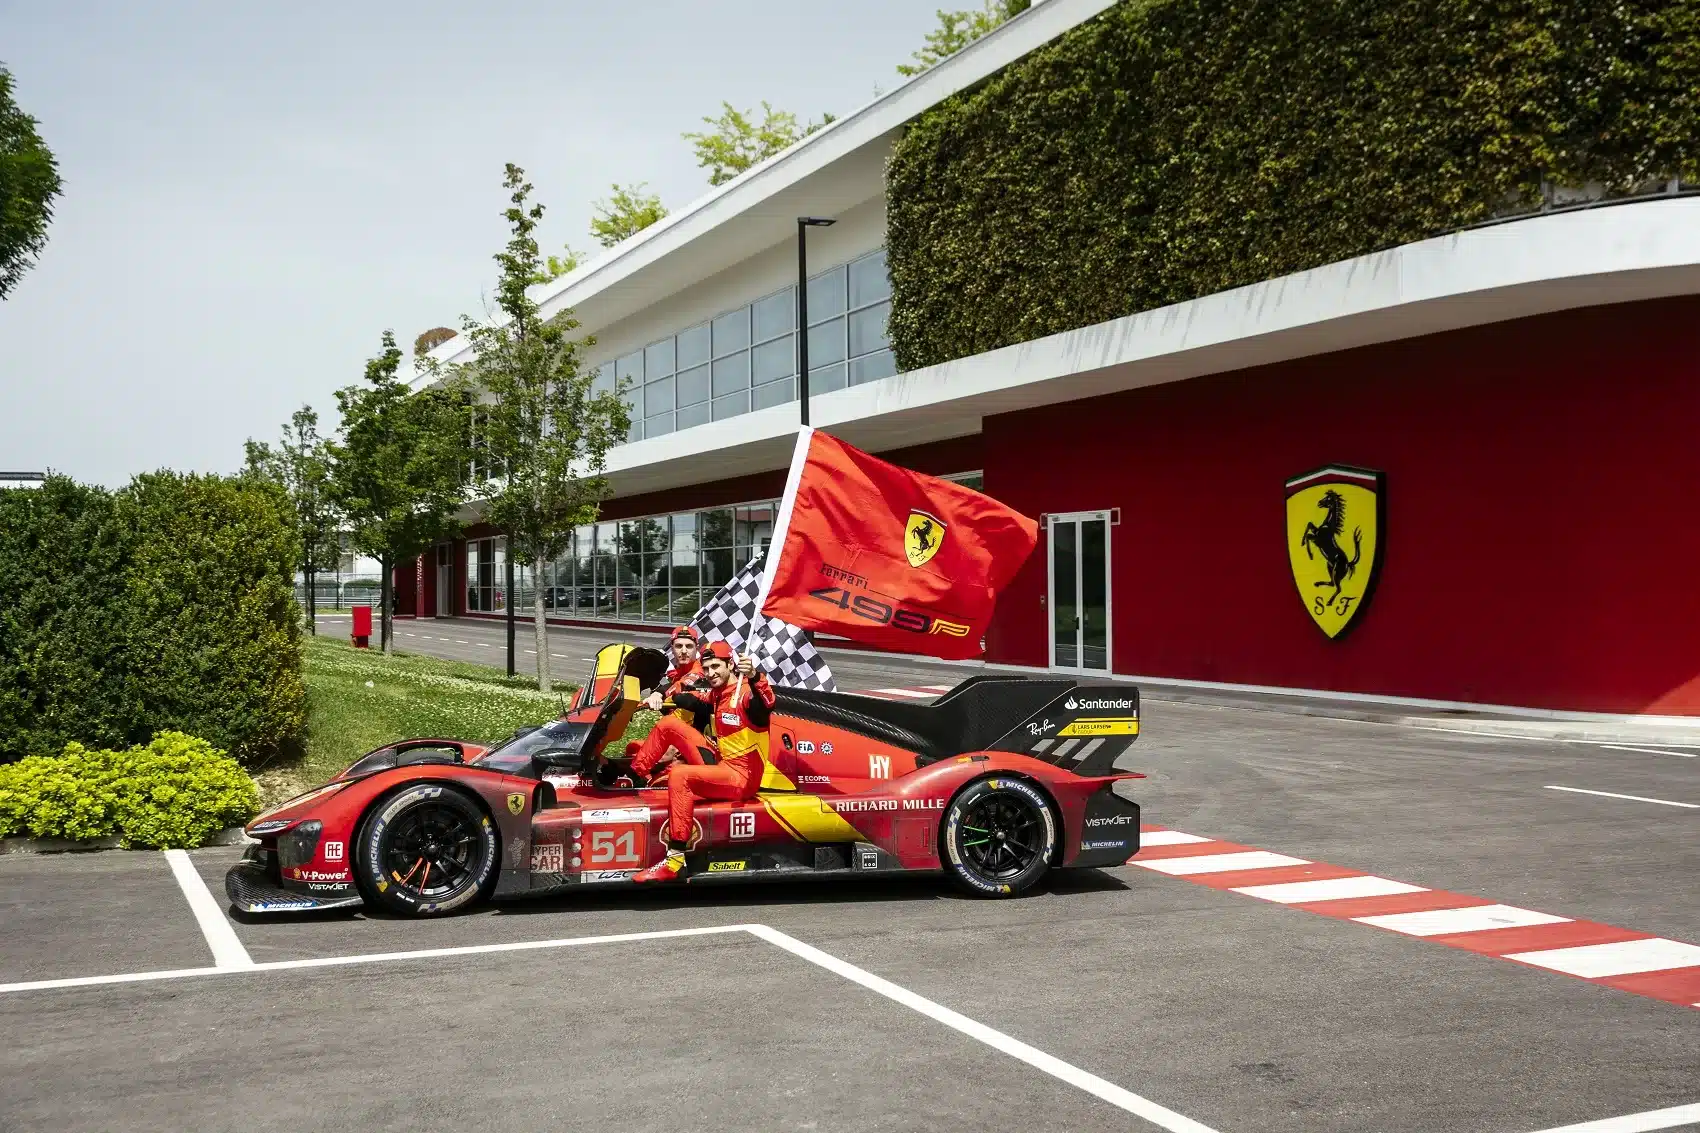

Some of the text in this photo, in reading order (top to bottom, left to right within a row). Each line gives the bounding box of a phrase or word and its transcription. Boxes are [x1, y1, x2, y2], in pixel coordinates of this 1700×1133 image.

[819, 564, 869, 589] Ferrari
[808, 587, 971, 637] 499P
[1314, 596, 1357, 616] S F
[1079, 698, 1133, 710] Santander
[1026, 719, 1056, 736] Ray-Ban
[869, 754, 890, 779] HY
[836, 799, 945, 812] RICHARD MILLE
[1005, 781, 1044, 806] MICHELIN
[370, 822, 385, 874] MICHELIN
[479, 834, 495, 884] MICHELIN
[591, 830, 640, 863] 51
[301, 870, 348, 880] V-Power
[712, 862, 741, 870] Sabelt
[957, 866, 995, 892] MICHELIN
